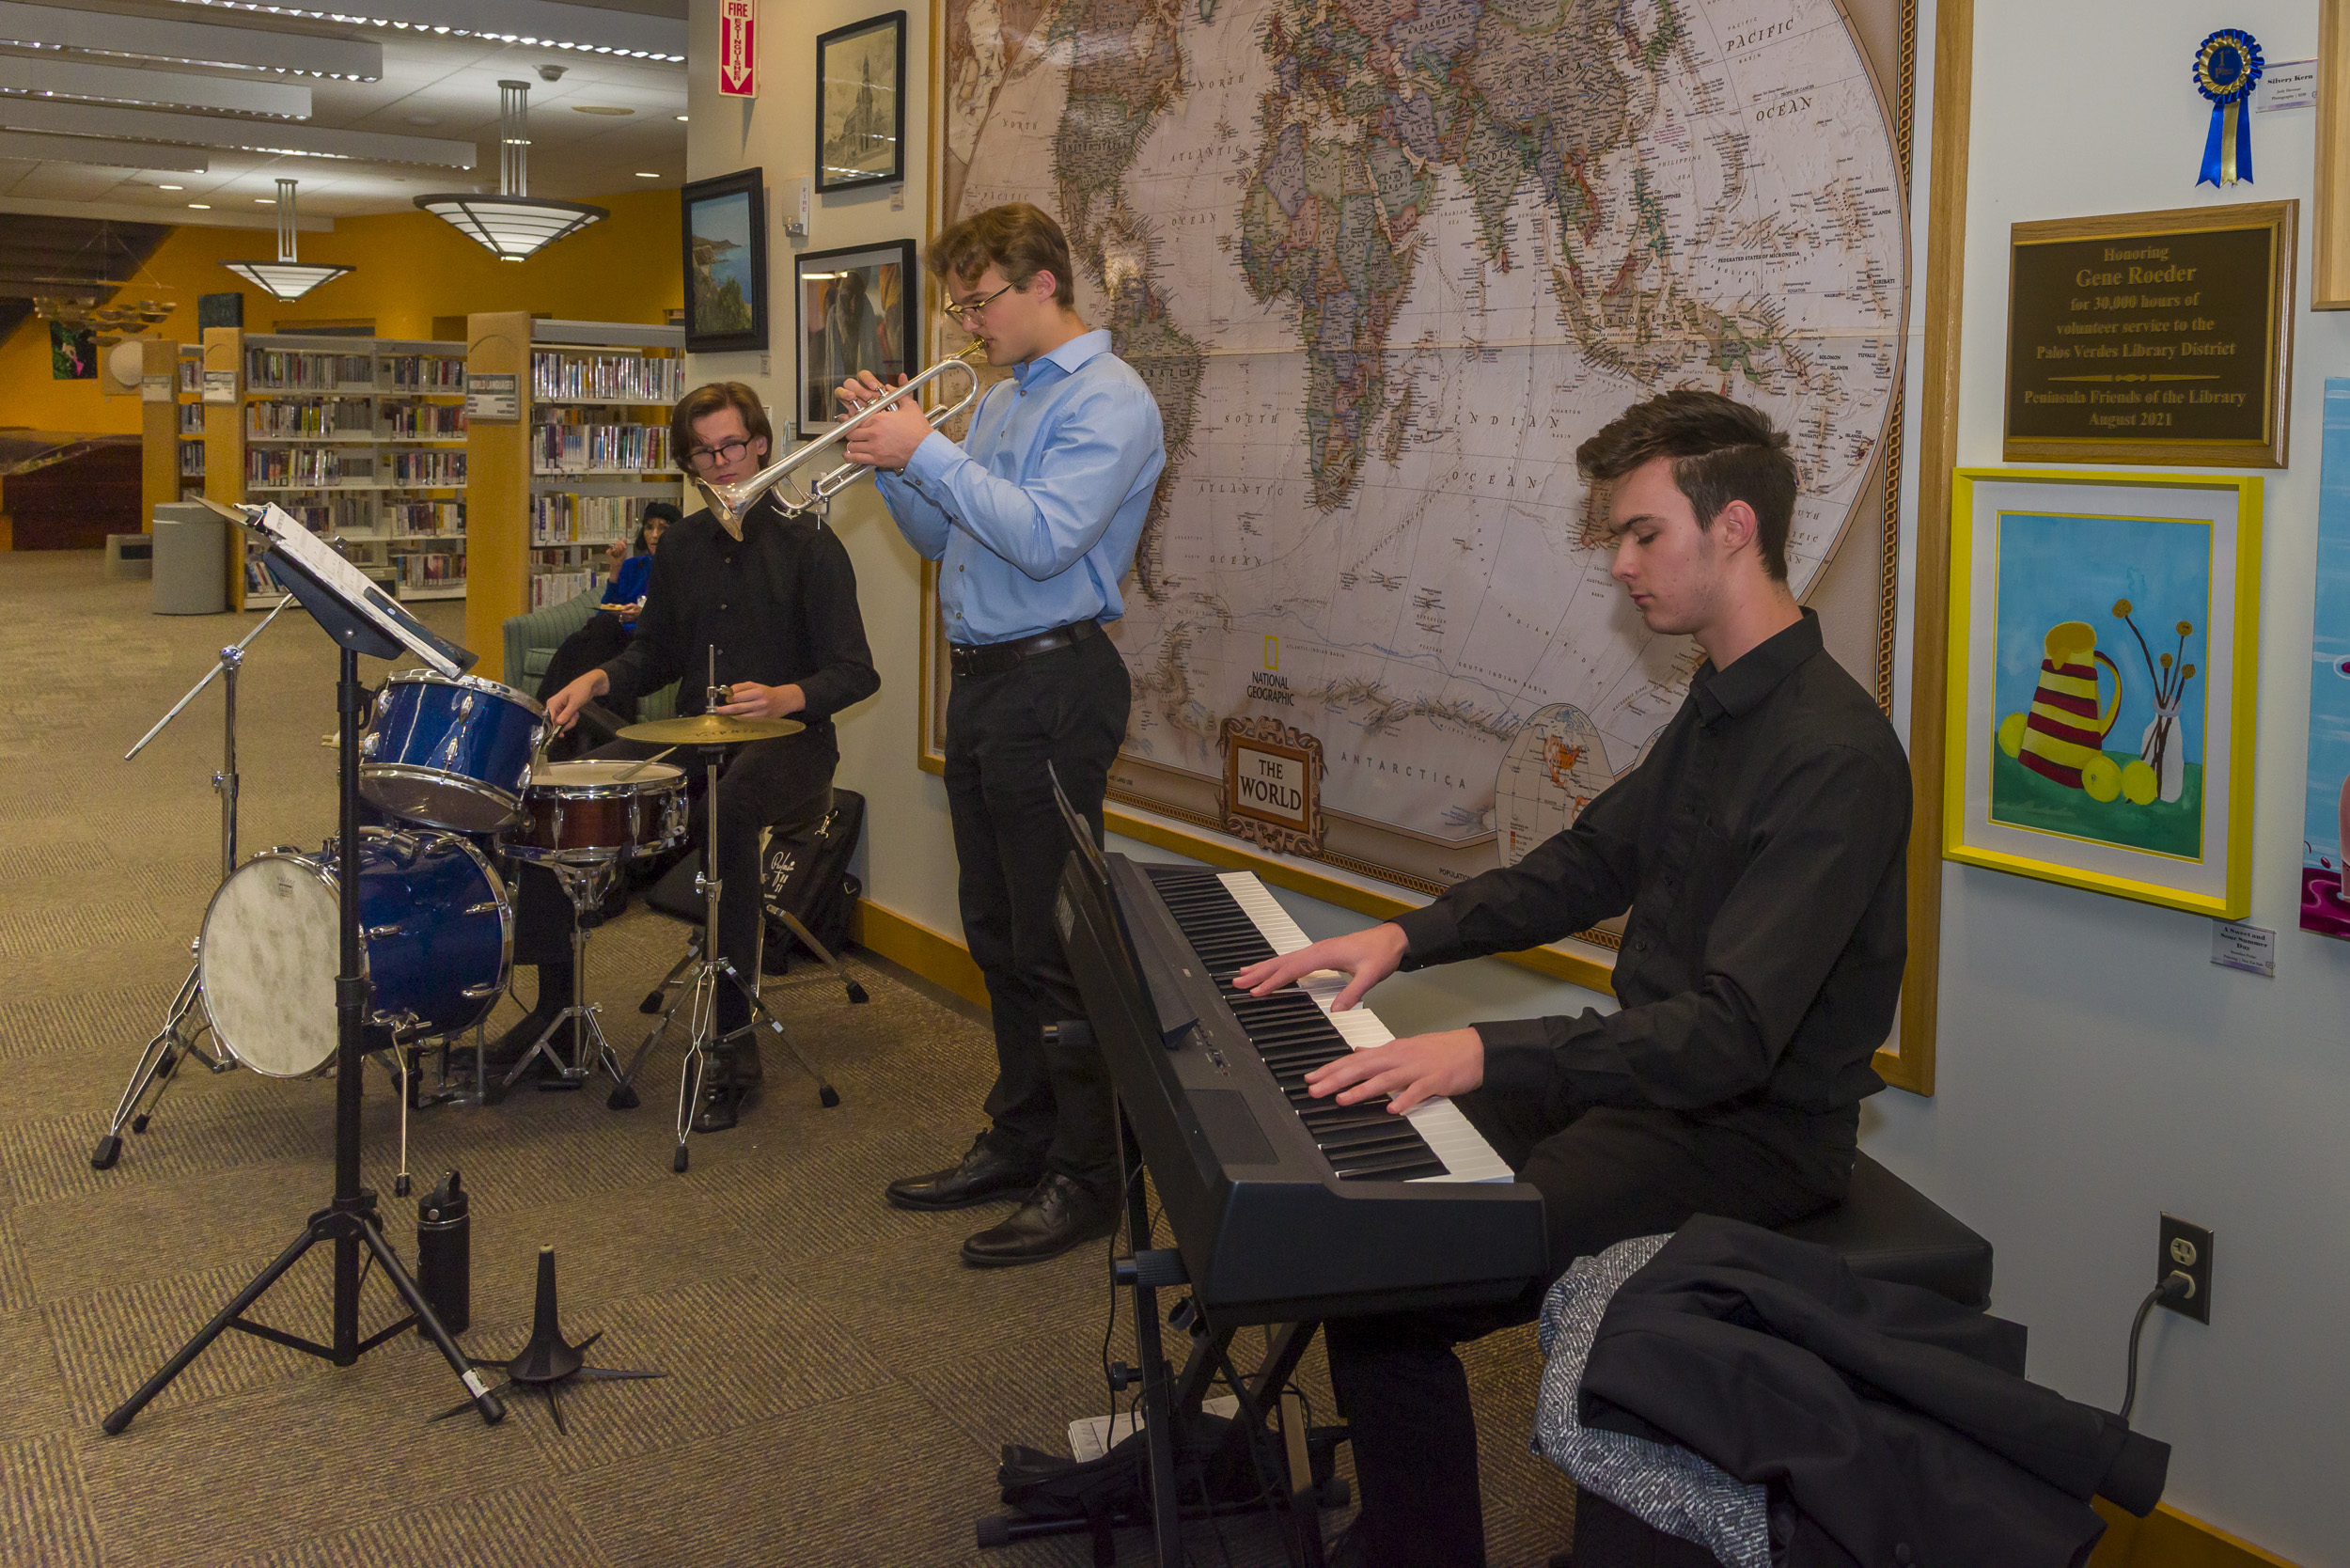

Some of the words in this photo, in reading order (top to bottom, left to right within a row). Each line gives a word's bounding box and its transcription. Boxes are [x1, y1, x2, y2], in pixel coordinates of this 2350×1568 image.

[728, 3, 748, 17] FIRE
[1408, 11, 1464, 35] KAZAKHSTAN
[1728, 16, 1758, 31] PACIFIC
[1724, 15, 1794, 53] PACIFIC
[733, 18, 743, 81] EXTINGUISHER
[1738, 54, 1762, 64] BASIN
[1198, 71, 1246, 91] NORTH
[1507, 62, 1583, 90] CHINA
[1622, 75, 1643, 84] Shanghai
[1756, 95, 1813, 121] OCEAN
[1002, 118, 1039, 132] NORTH
[1443, 133, 1466, 142] PAKISTAN
[1062, 142, 1093, 151] UNITED
[1097, 142, 1128, 151] STATES
[1167, 144, 1241, 167] ATLANTIC
[1477, 149, 1512, 164] INDIA
[1657, 154, 1701, 168] PHILIPPINE
[1271, 167, 1300, 176] ALGERIA
[983, 191, 1030, 202] PACIFIC
[1654, 193, 1681, 201] PHILIPPINES
[1171, 212, 1216, 227] OCEAN
[1440, 209, 1468, 217] ARABIAN
[1769, 251, 1800, 259] MICRONESIA
[2103, 245, 2170, 262] Honoring
[1704, 260, 1756, 276] CAROLINE
[1765, 252, 1815, 275] ISLANDS
[2076, 269, 2123, 288] Gene
[2128, 264, 2198, 285] Roeder
[2070, 297, 2090, 311] for
[2092, 295, 2137, 311] 30,000
[2140, 294, 2180, 308] hours
[2185, 292, 2201, 306] of
[1598, 314, 1689, 325] INDONESIA
[2056, 321, 2118, 335] volunteer
[2123, 320, 2170, 333] service
[2173, 319, 2186, 331] to
[2191, 317, 2215, 330] the
[2036, 345, 2070, 359] Palos
[2074, 344, 2118, 357] Verdes
[2123, 343, 2177, 360] Library
[2181, 341, 2236, 356] District
[2024, 390, 2086, 404] Peninsula
[2090, 390, 2140, 404] Friends
[2144, 390, 2159, 403] of
[2162, 390, 2185, 403] the
[2188, 389, 2247, 408] Library
[1224, 414, 1280, 424] SOUTH
[1453, 411, 1559, 429] INDIAN
[2088, 413, 2137, 429] August
[2139, 413, 2172, 426] 2021
[1451, 470, 1538, 489] OCEAN
[1198, 482, 1284, 496] ATLANTIC
[1210, 555, 1262, 567] OCEAN
[1587, 578, 1613, 588] AUSTRALIAN
[1252, 670, 1290, 690] NATIONAL
[1458, 661, 1483, 673] SOUTH
[1489, 669, 1518, 684] INDIAN
[1523, 682, 1547, 696] BASIN
[1246, 684, 1294, 707] GEOGRAPHIC
[1259, 759, 1284, 780] THE
[1340, 751, 1466, 790] ANTARCTICA
[1240, 776, 1302, 810] WORLD
[2220, 933, 2237, 941] Sour
[2238, 937, 2269, 948] Summer
[2230, 928, 2250, 937] Sweet
